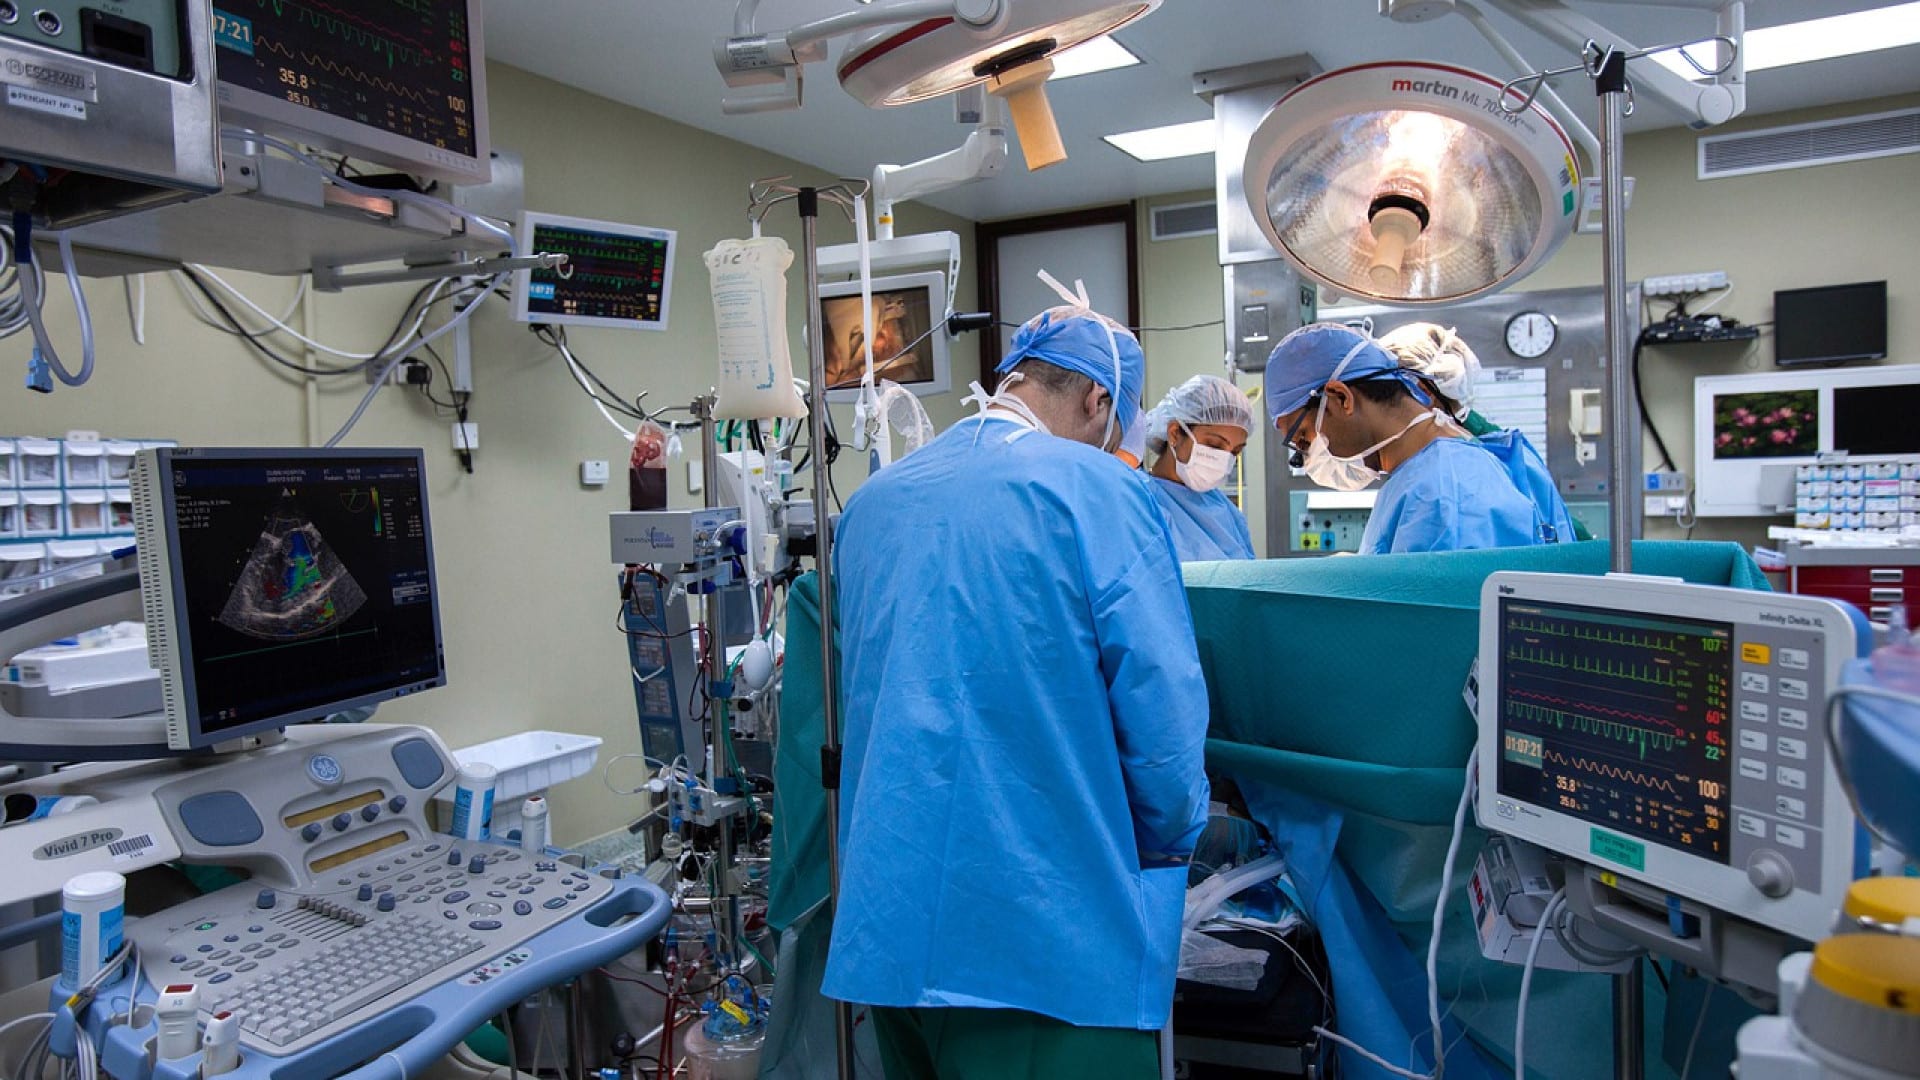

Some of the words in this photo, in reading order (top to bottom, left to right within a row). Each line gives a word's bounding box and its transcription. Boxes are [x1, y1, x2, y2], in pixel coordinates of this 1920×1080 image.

[279, 67, 309, 90] 35.8
[287, 90, 311, 107] 35.0
[1392, 78, 1459, 100] martin
[1461, 90, 1481, 107] ML
[447, 95, 466, 113] 100
[1702, 638, 1720, 652] 107
[1706, 710, 1720, 725] 60
[1705, 730, 1720, 745] 45
[1505, 735, 1542, 758] 01:07:21
[1705, 745, 1719, 760] 22
[1556, 775, 1576, 793] 35.8
[1698, 780, 1720, 799] 100
[1560, 795, 1576, 808] 35.0
[1706, 816, 1719, 830] 30
[43, 839, 79, 858] Vivid
[80, 836, 88, 847] 7
[91, 831, 113, 845] Pro
